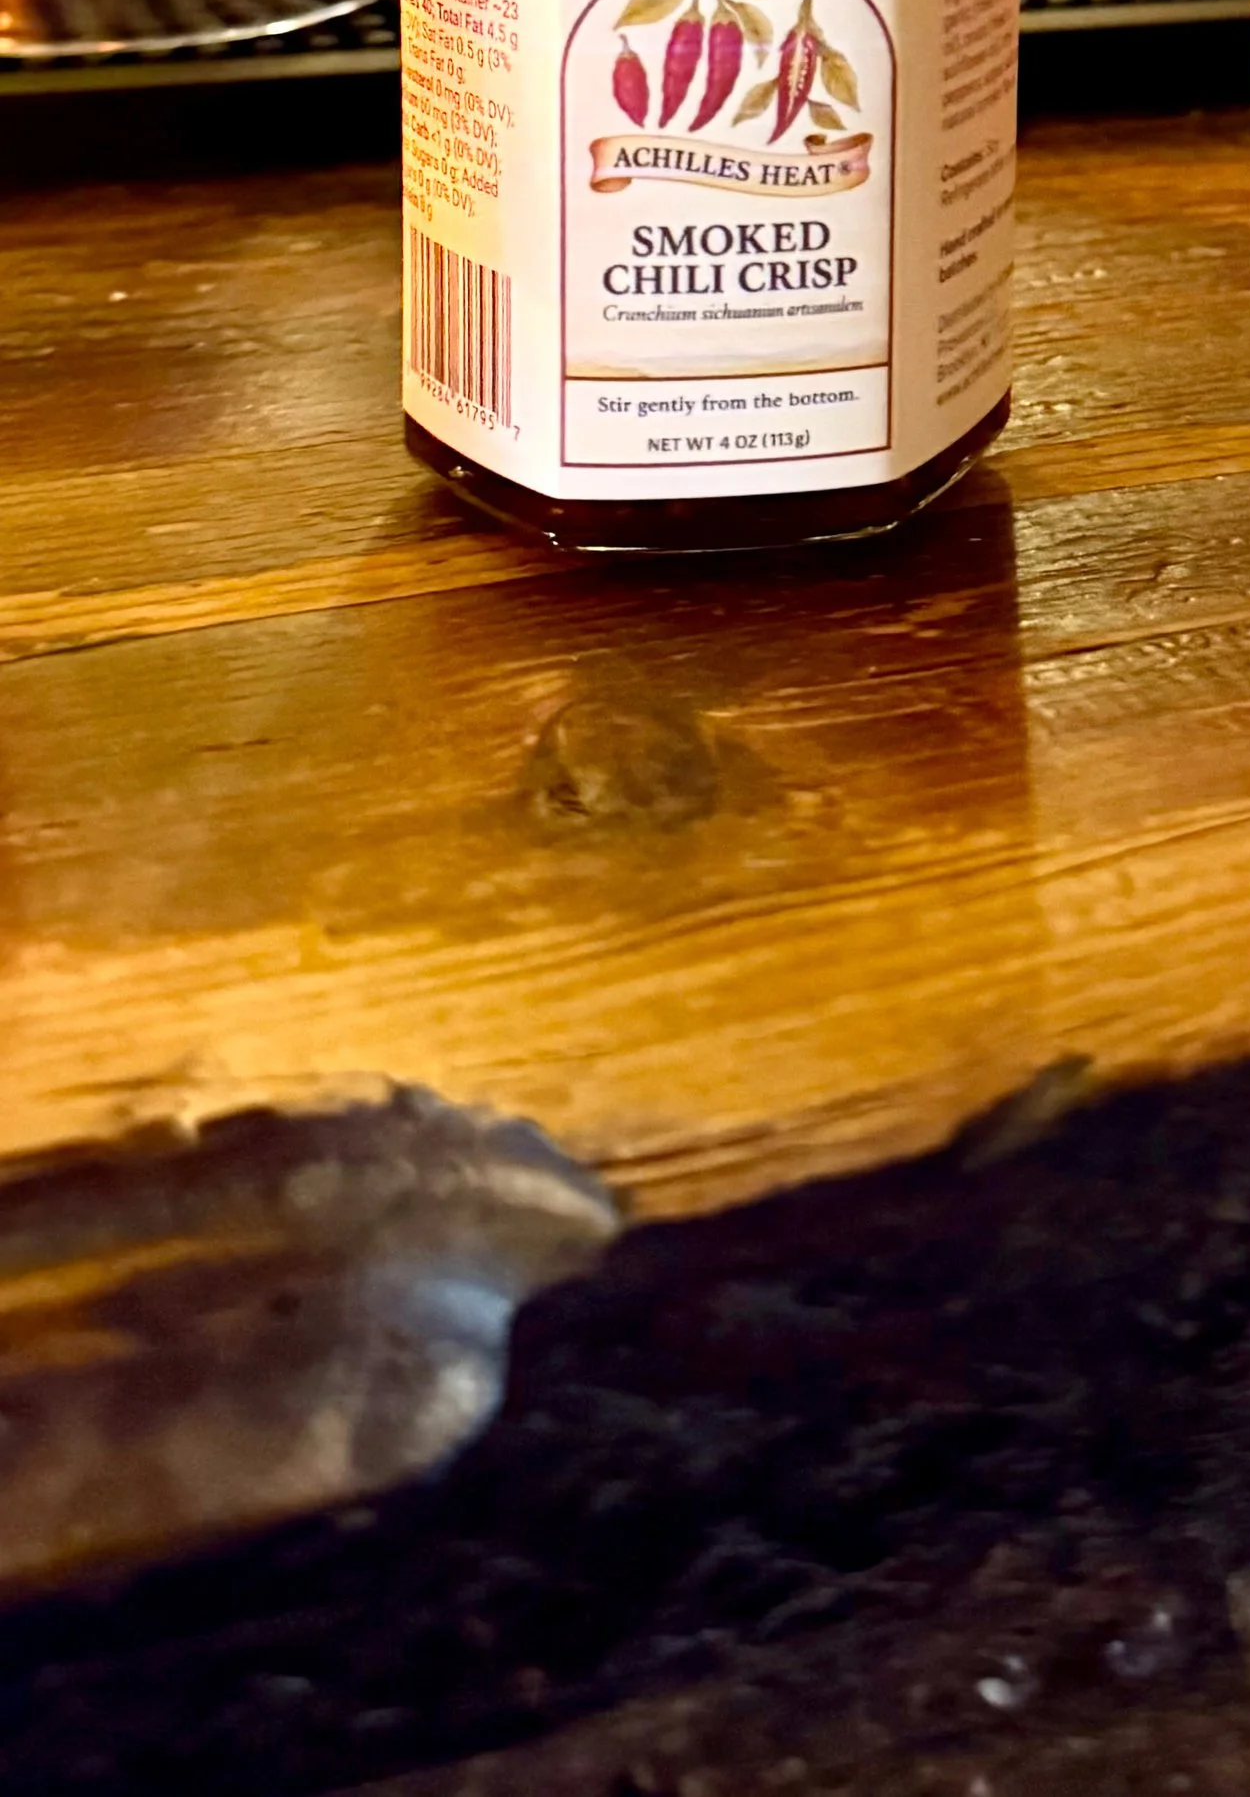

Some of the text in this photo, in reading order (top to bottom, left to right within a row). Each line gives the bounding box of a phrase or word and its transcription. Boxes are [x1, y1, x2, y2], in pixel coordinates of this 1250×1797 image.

[437, 1, 462, 28] Total
[465, 13, 484, 36] Fat
[487, 20, 506, 43] 4.5
[510, 32, 518, 51] g
[447, 58, 454, 76] 0
[456, 35, 474, 59] 0.5
[477, 48, 484, 68] g
[436, 78, 442, 97] 0
[444, 87, 460, 110] mg
[441, 157, 448, 175] 0
[462, 167, 498, 198] Added
[613, 147, 751, 182] ACHILLES
[631, 220, 831, 257] SMOKED
[602, 257, 858, 296] CHILI CRISP
[456, 399, 495, 430] 61795
[513, 425, 521, 442] 7
[598, 389, 860, 417] Stir gently from the bottom.
[648, 429, 811, 452] NET WT 4 OZ (113g)
